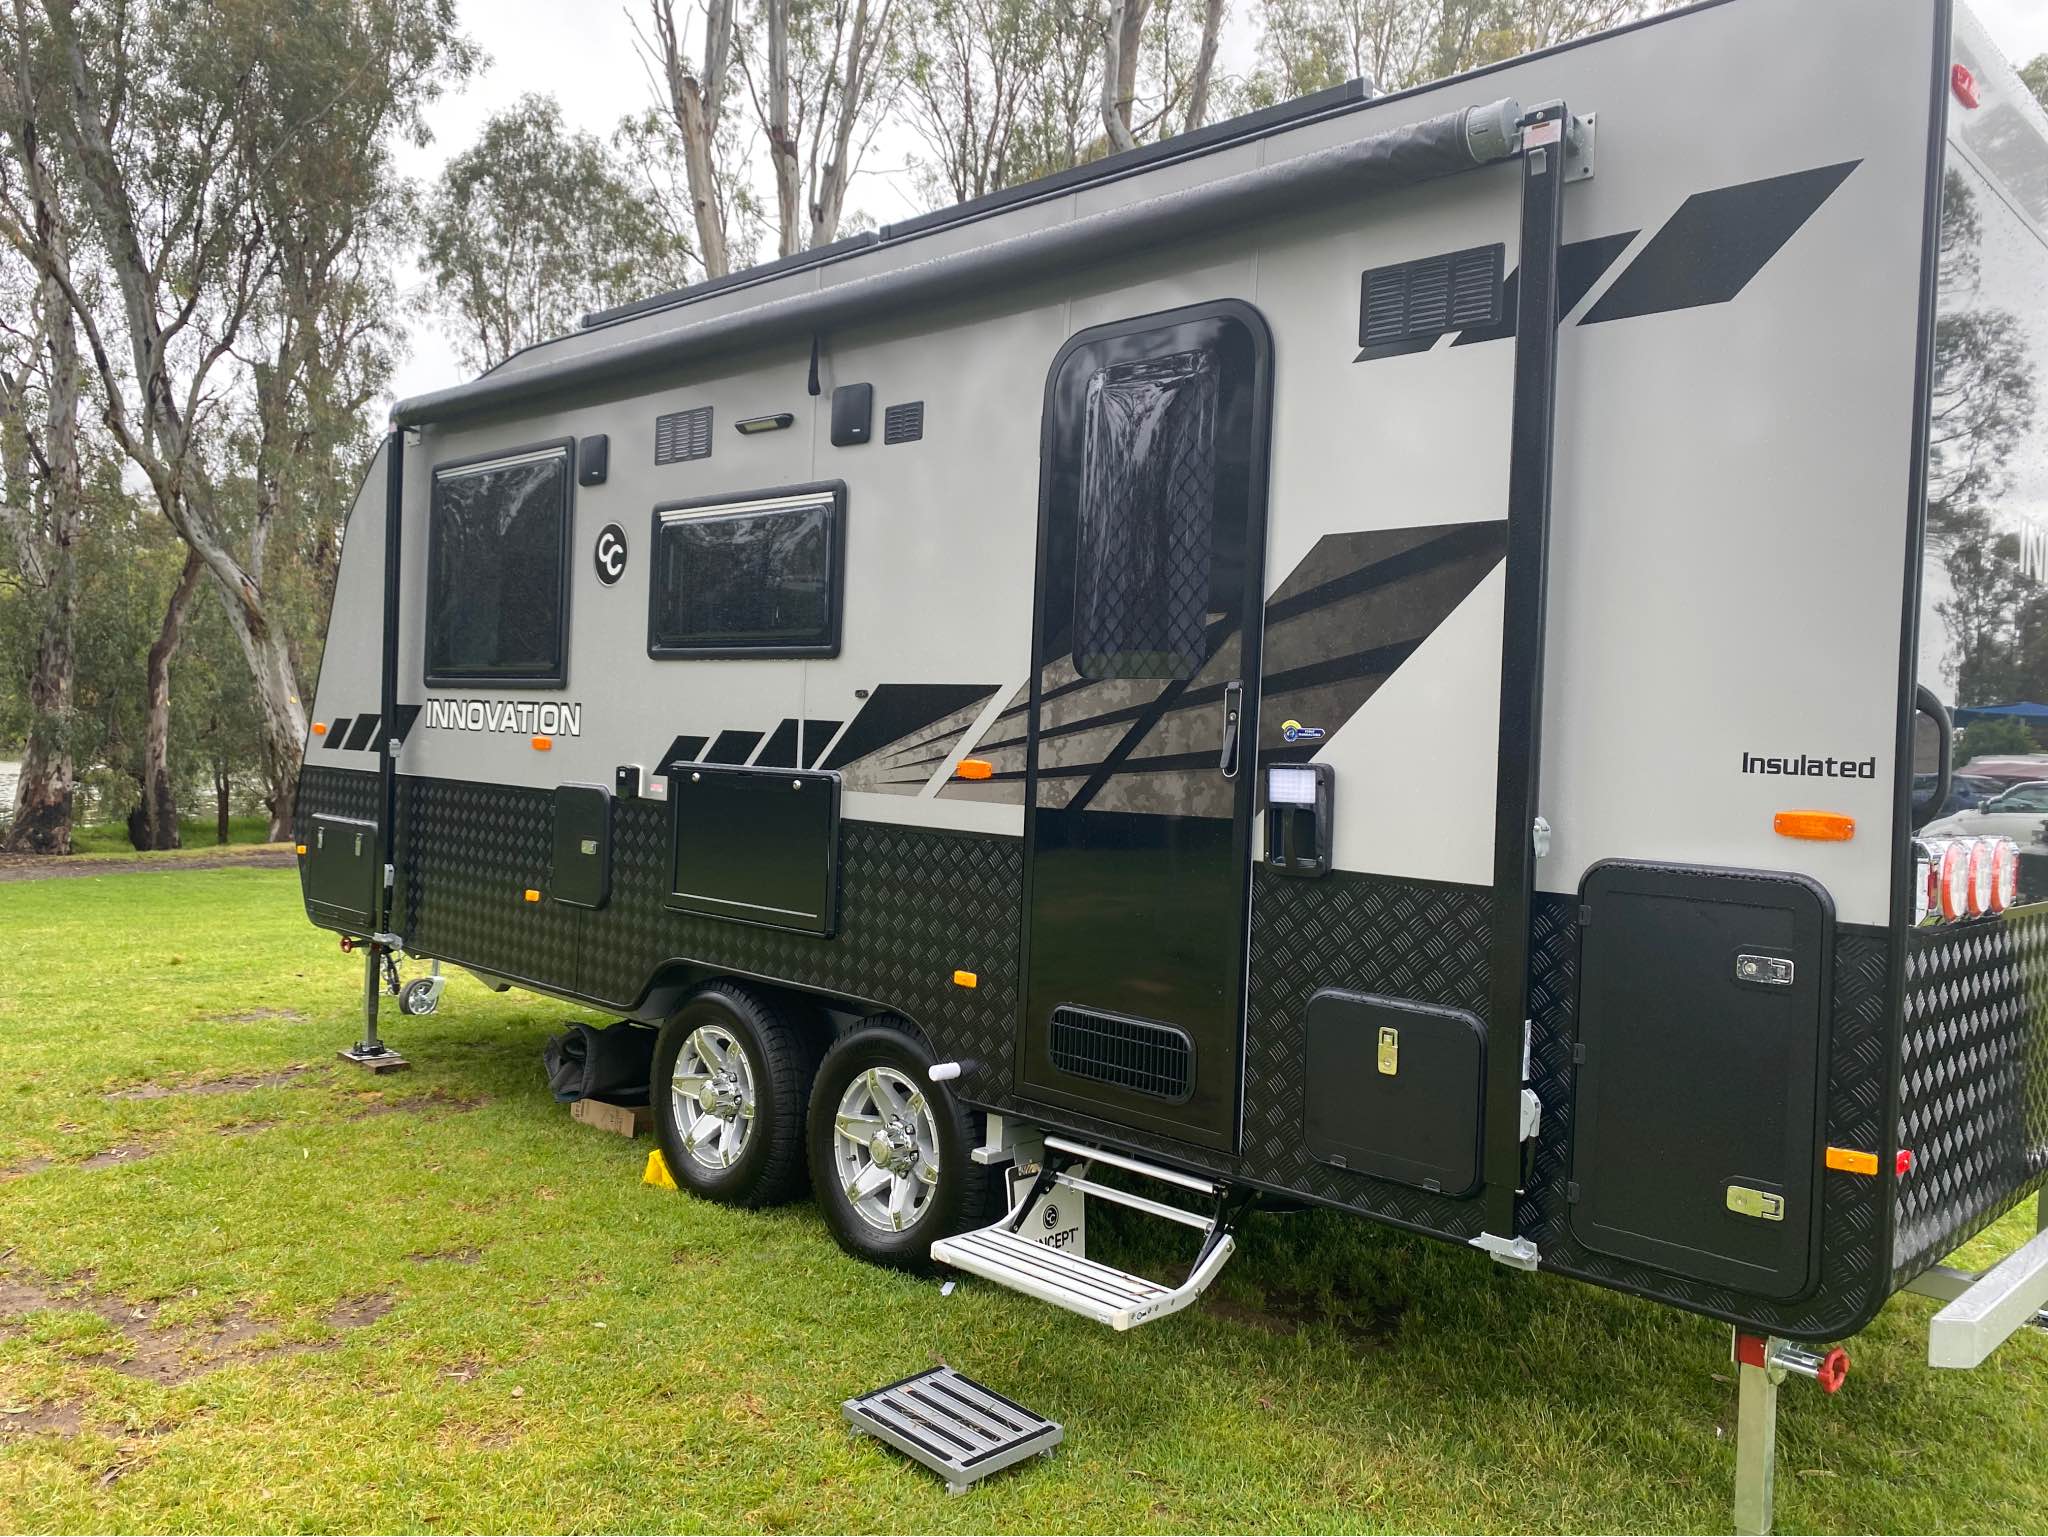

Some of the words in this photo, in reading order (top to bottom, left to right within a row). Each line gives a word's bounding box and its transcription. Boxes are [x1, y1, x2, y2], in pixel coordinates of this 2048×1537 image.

[598, 532, 624, 576] CC
[425, 698, 582, 737] INNOVATION
[1742, 751, 1876, 779] Insulated
